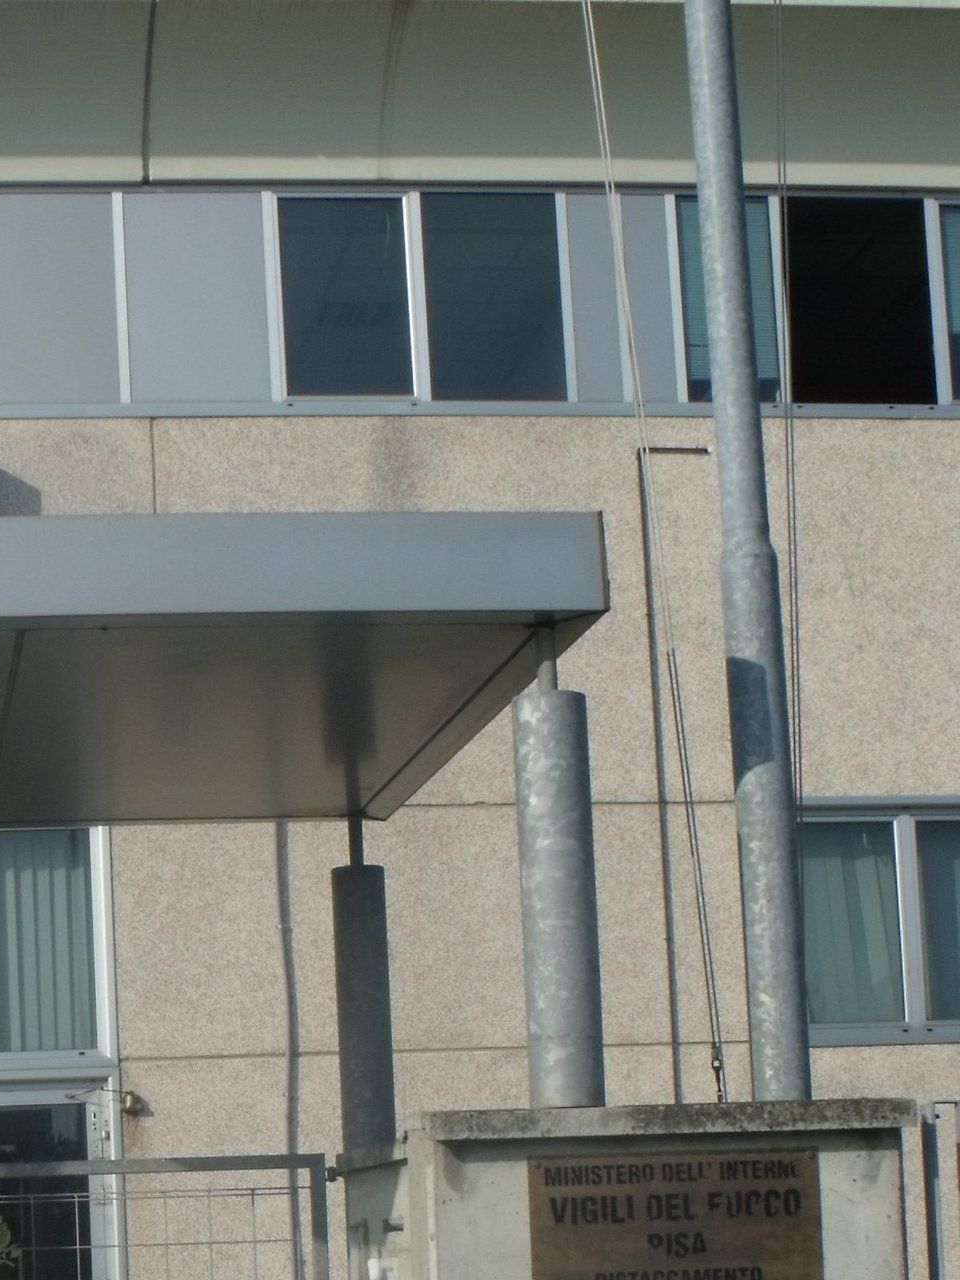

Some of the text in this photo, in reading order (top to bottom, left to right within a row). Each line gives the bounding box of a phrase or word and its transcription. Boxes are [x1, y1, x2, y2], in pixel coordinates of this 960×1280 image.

[544, 1163, 655, 1187] MINISTERO
[662, 1161, 712, 1183] DELL'
[549, 1195, 635, 1226] VIGILI
[646, 1192, 699, 1222] DEL
[647, 1231, 708, 1258] PISA
